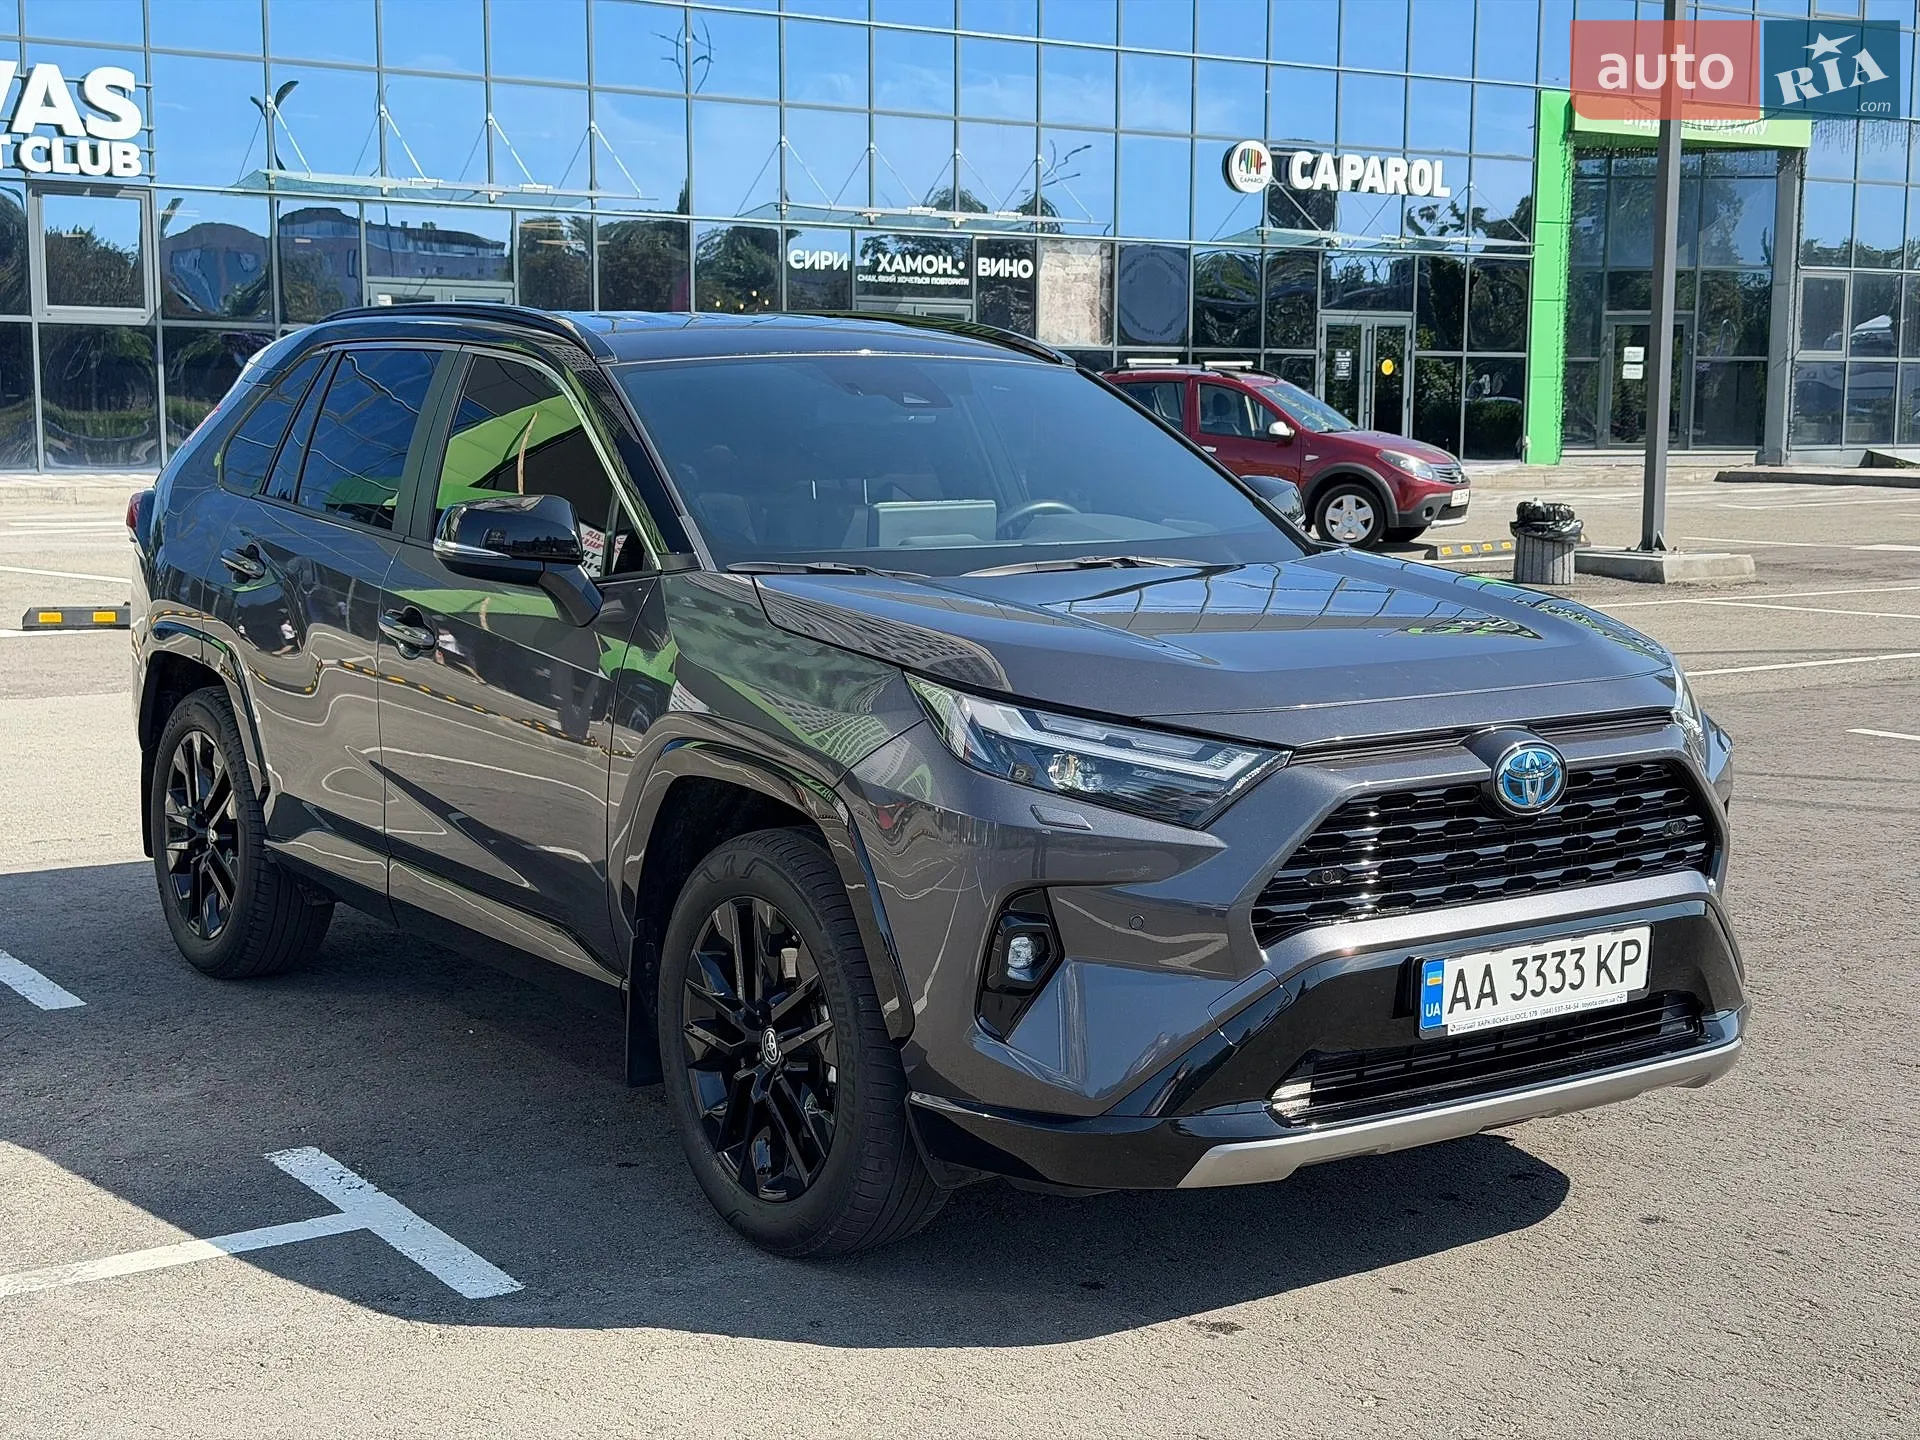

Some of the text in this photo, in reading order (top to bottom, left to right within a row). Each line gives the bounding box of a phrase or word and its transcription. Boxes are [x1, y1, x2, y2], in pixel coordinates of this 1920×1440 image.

[19, 136, 143, 177] CLUB
[1289, 151, 1451, 198] CAPAROL
[788, 249, 1034, 279] СИРИ ХАМОН ВИНО
[1447, 939, 1642, 1015] AA 3333 KP
[1425, 1002, 1441, 1017] UA
